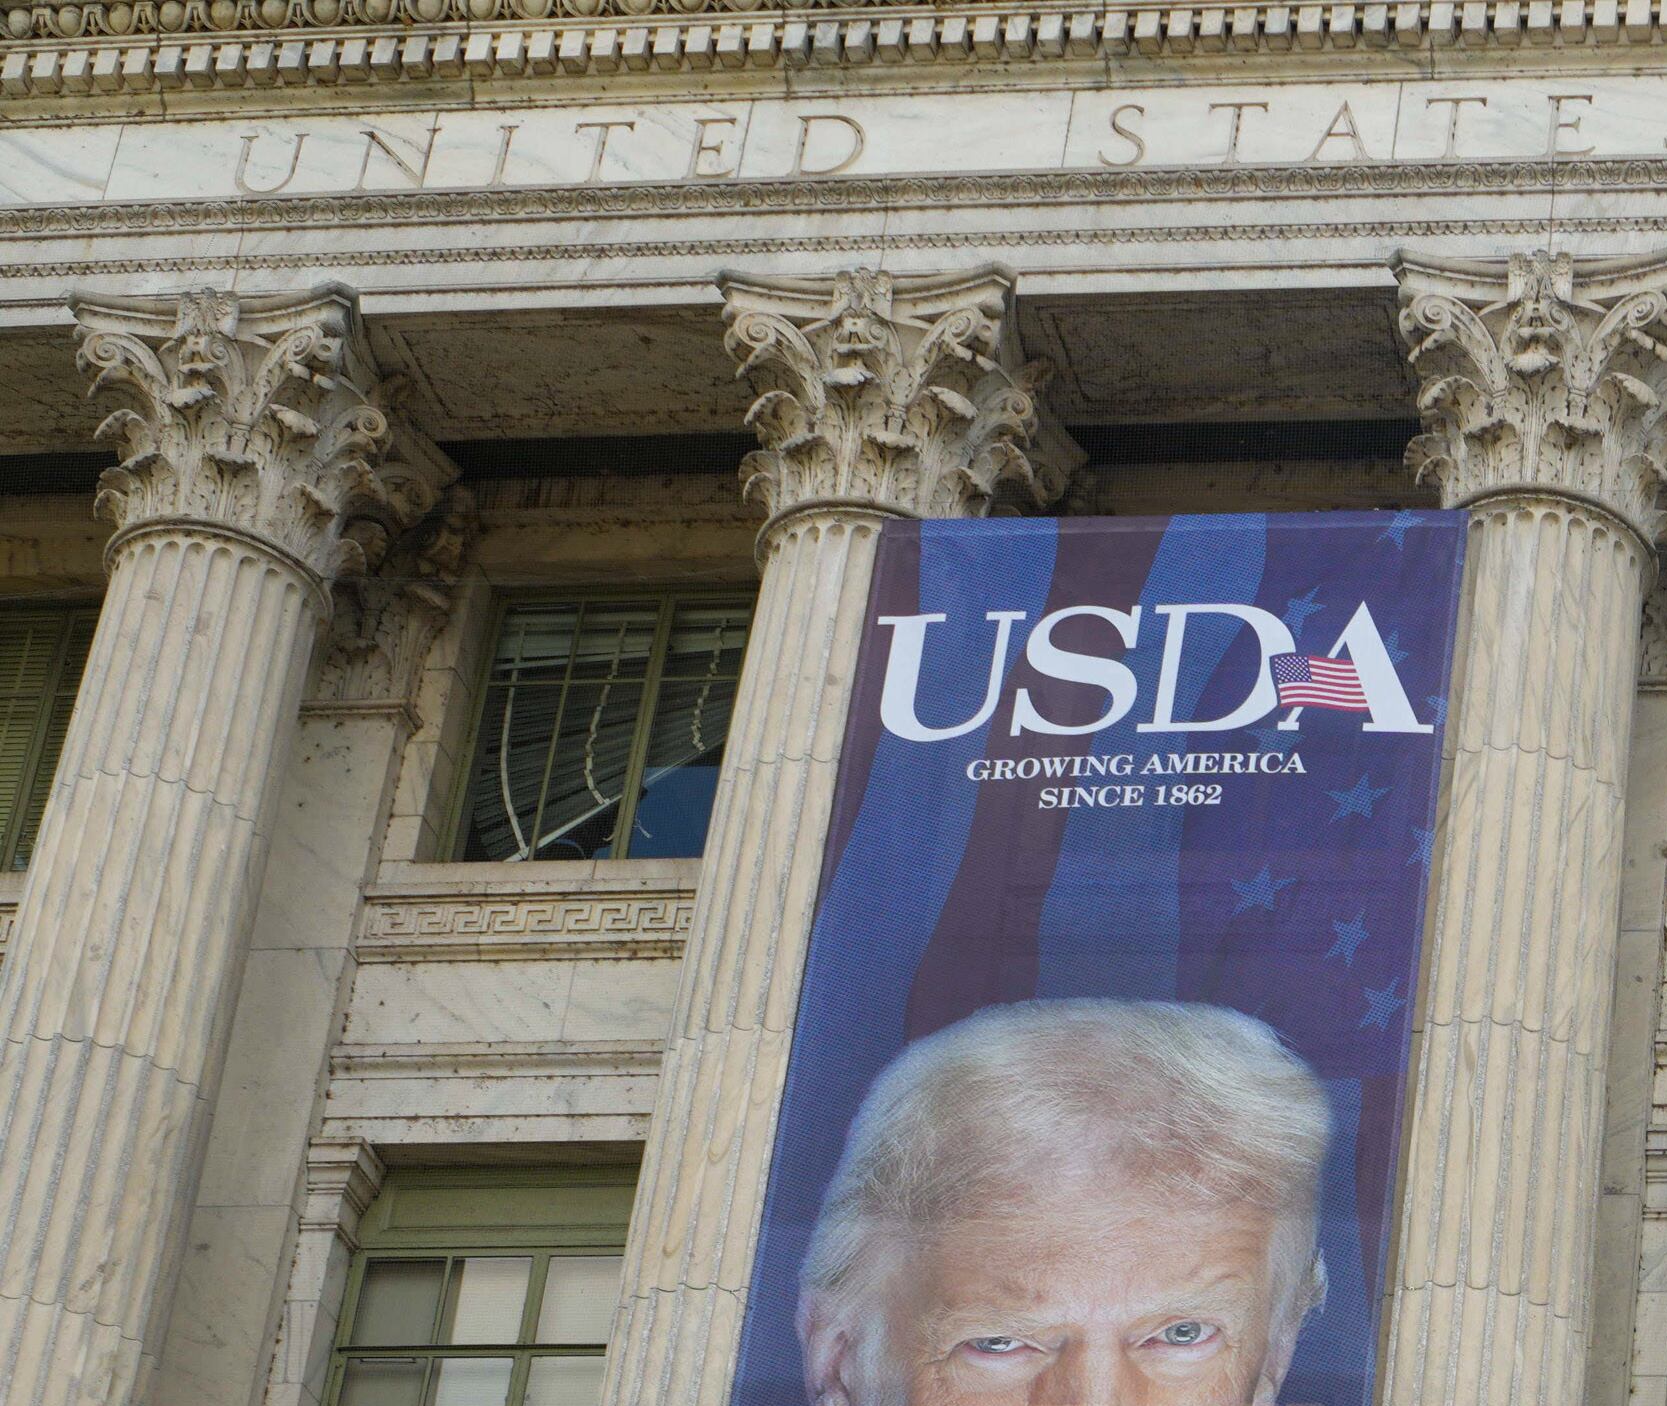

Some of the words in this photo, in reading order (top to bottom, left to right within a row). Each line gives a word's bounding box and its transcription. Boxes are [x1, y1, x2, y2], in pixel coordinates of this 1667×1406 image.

[234, 114, 866, 194] UNITED
[877, 600, 1434, 742] USDA
[965, 754, 1136, 781] GROWING
[1139, 751, 1308, 775] AMERICA
[1037, 785, 1144, 810] SINCE
[1152, 783, 1224, 806] 1862
